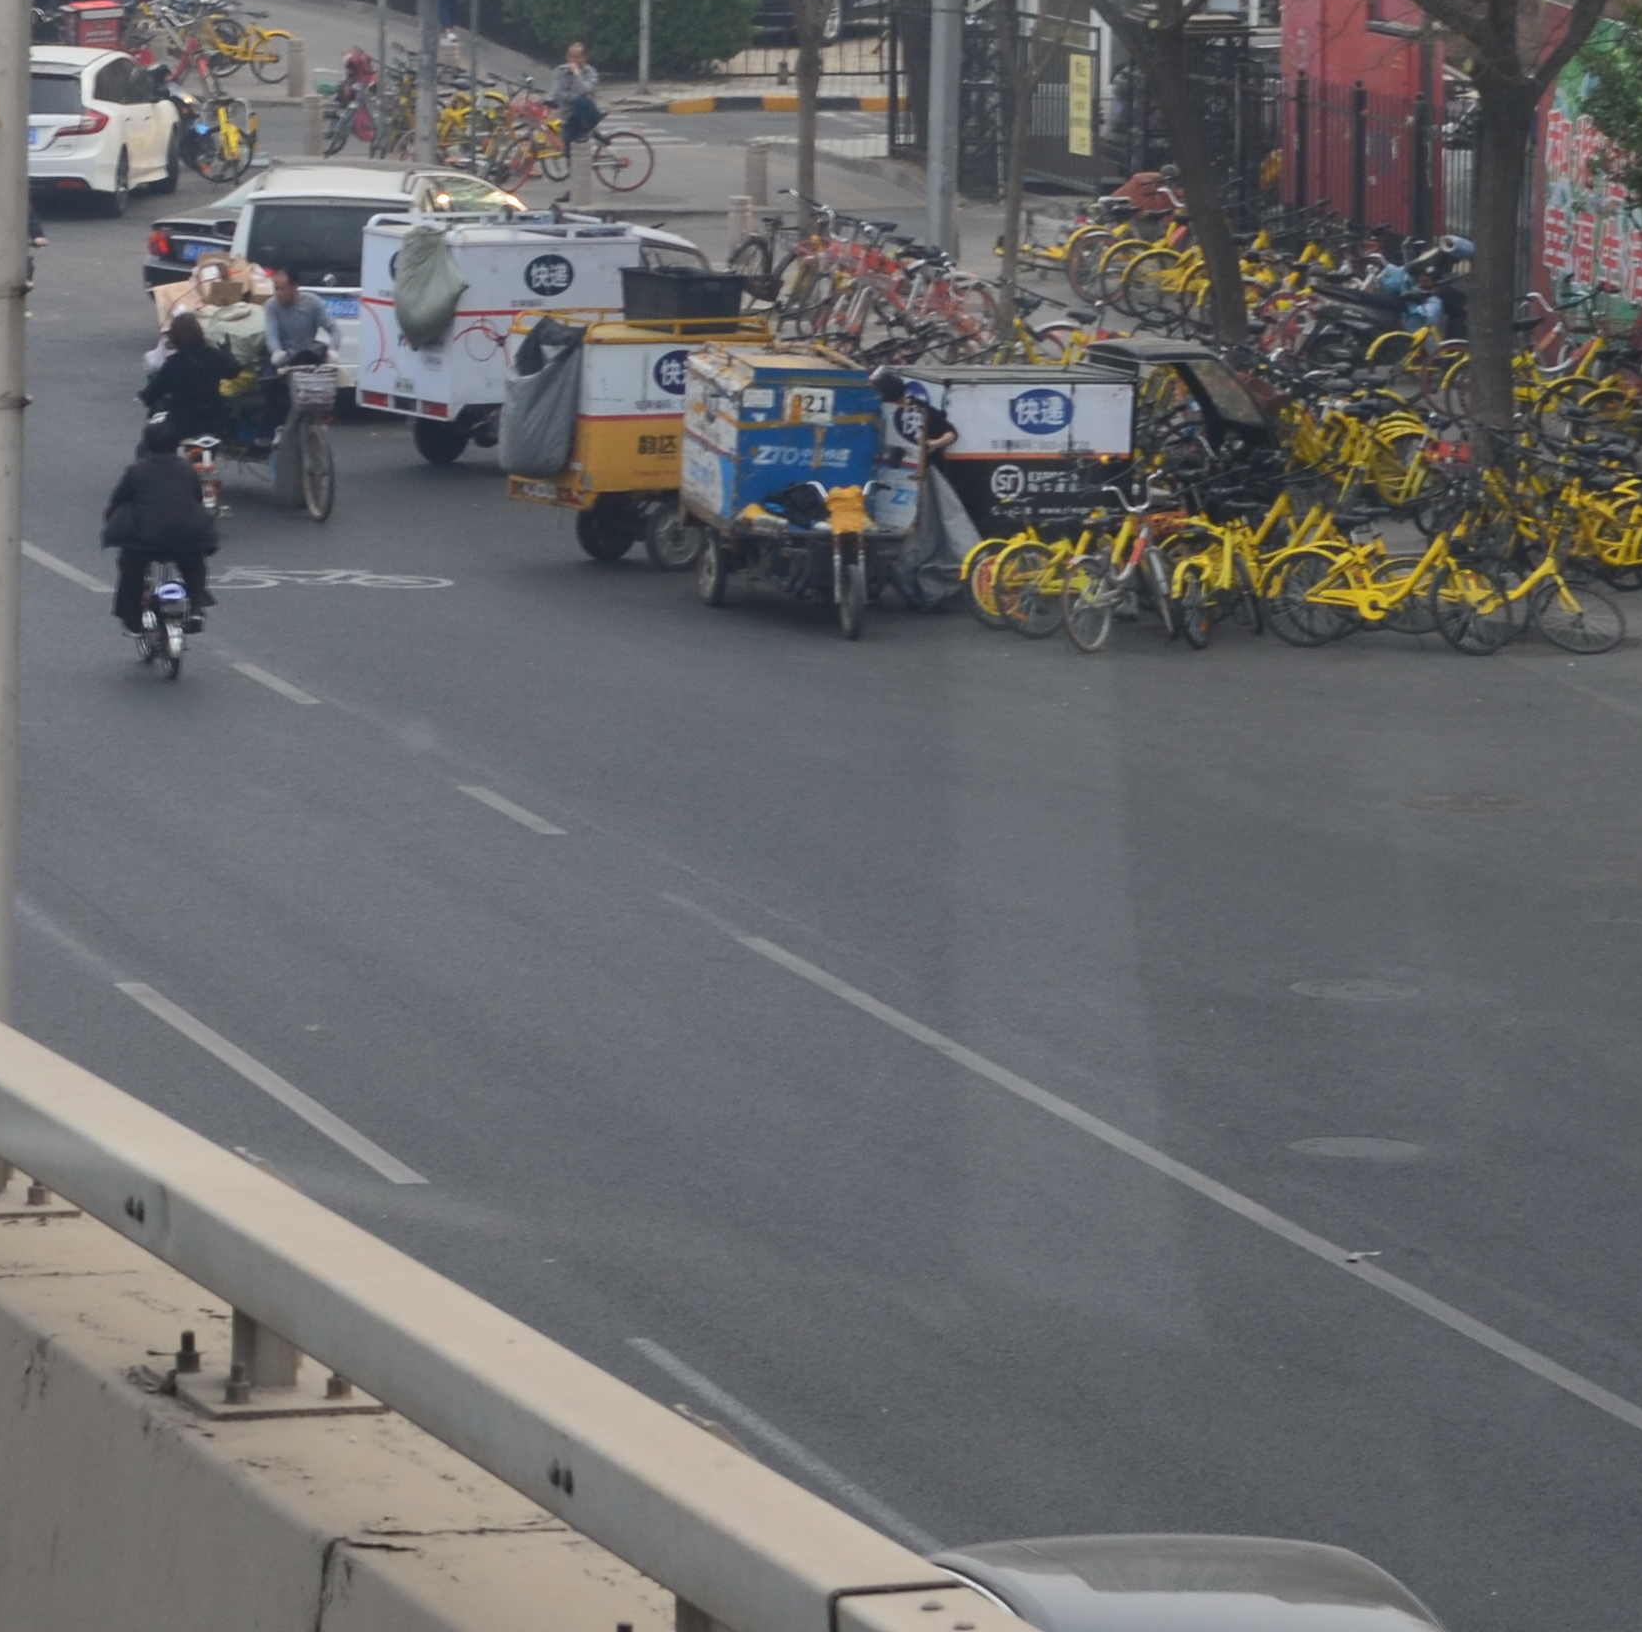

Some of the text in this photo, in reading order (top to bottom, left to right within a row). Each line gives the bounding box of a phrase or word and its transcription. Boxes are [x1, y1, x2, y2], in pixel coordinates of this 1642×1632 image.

[529, 262, 569, 288] 快递
[659, 359, 686, 386] 快
[804, 395, 827, 413] 21
[1014, 396, 1065, 426] 快递
[637, 434, 677, 455] 韵达
[752, 445, 851, 466] ZTO 中快递
